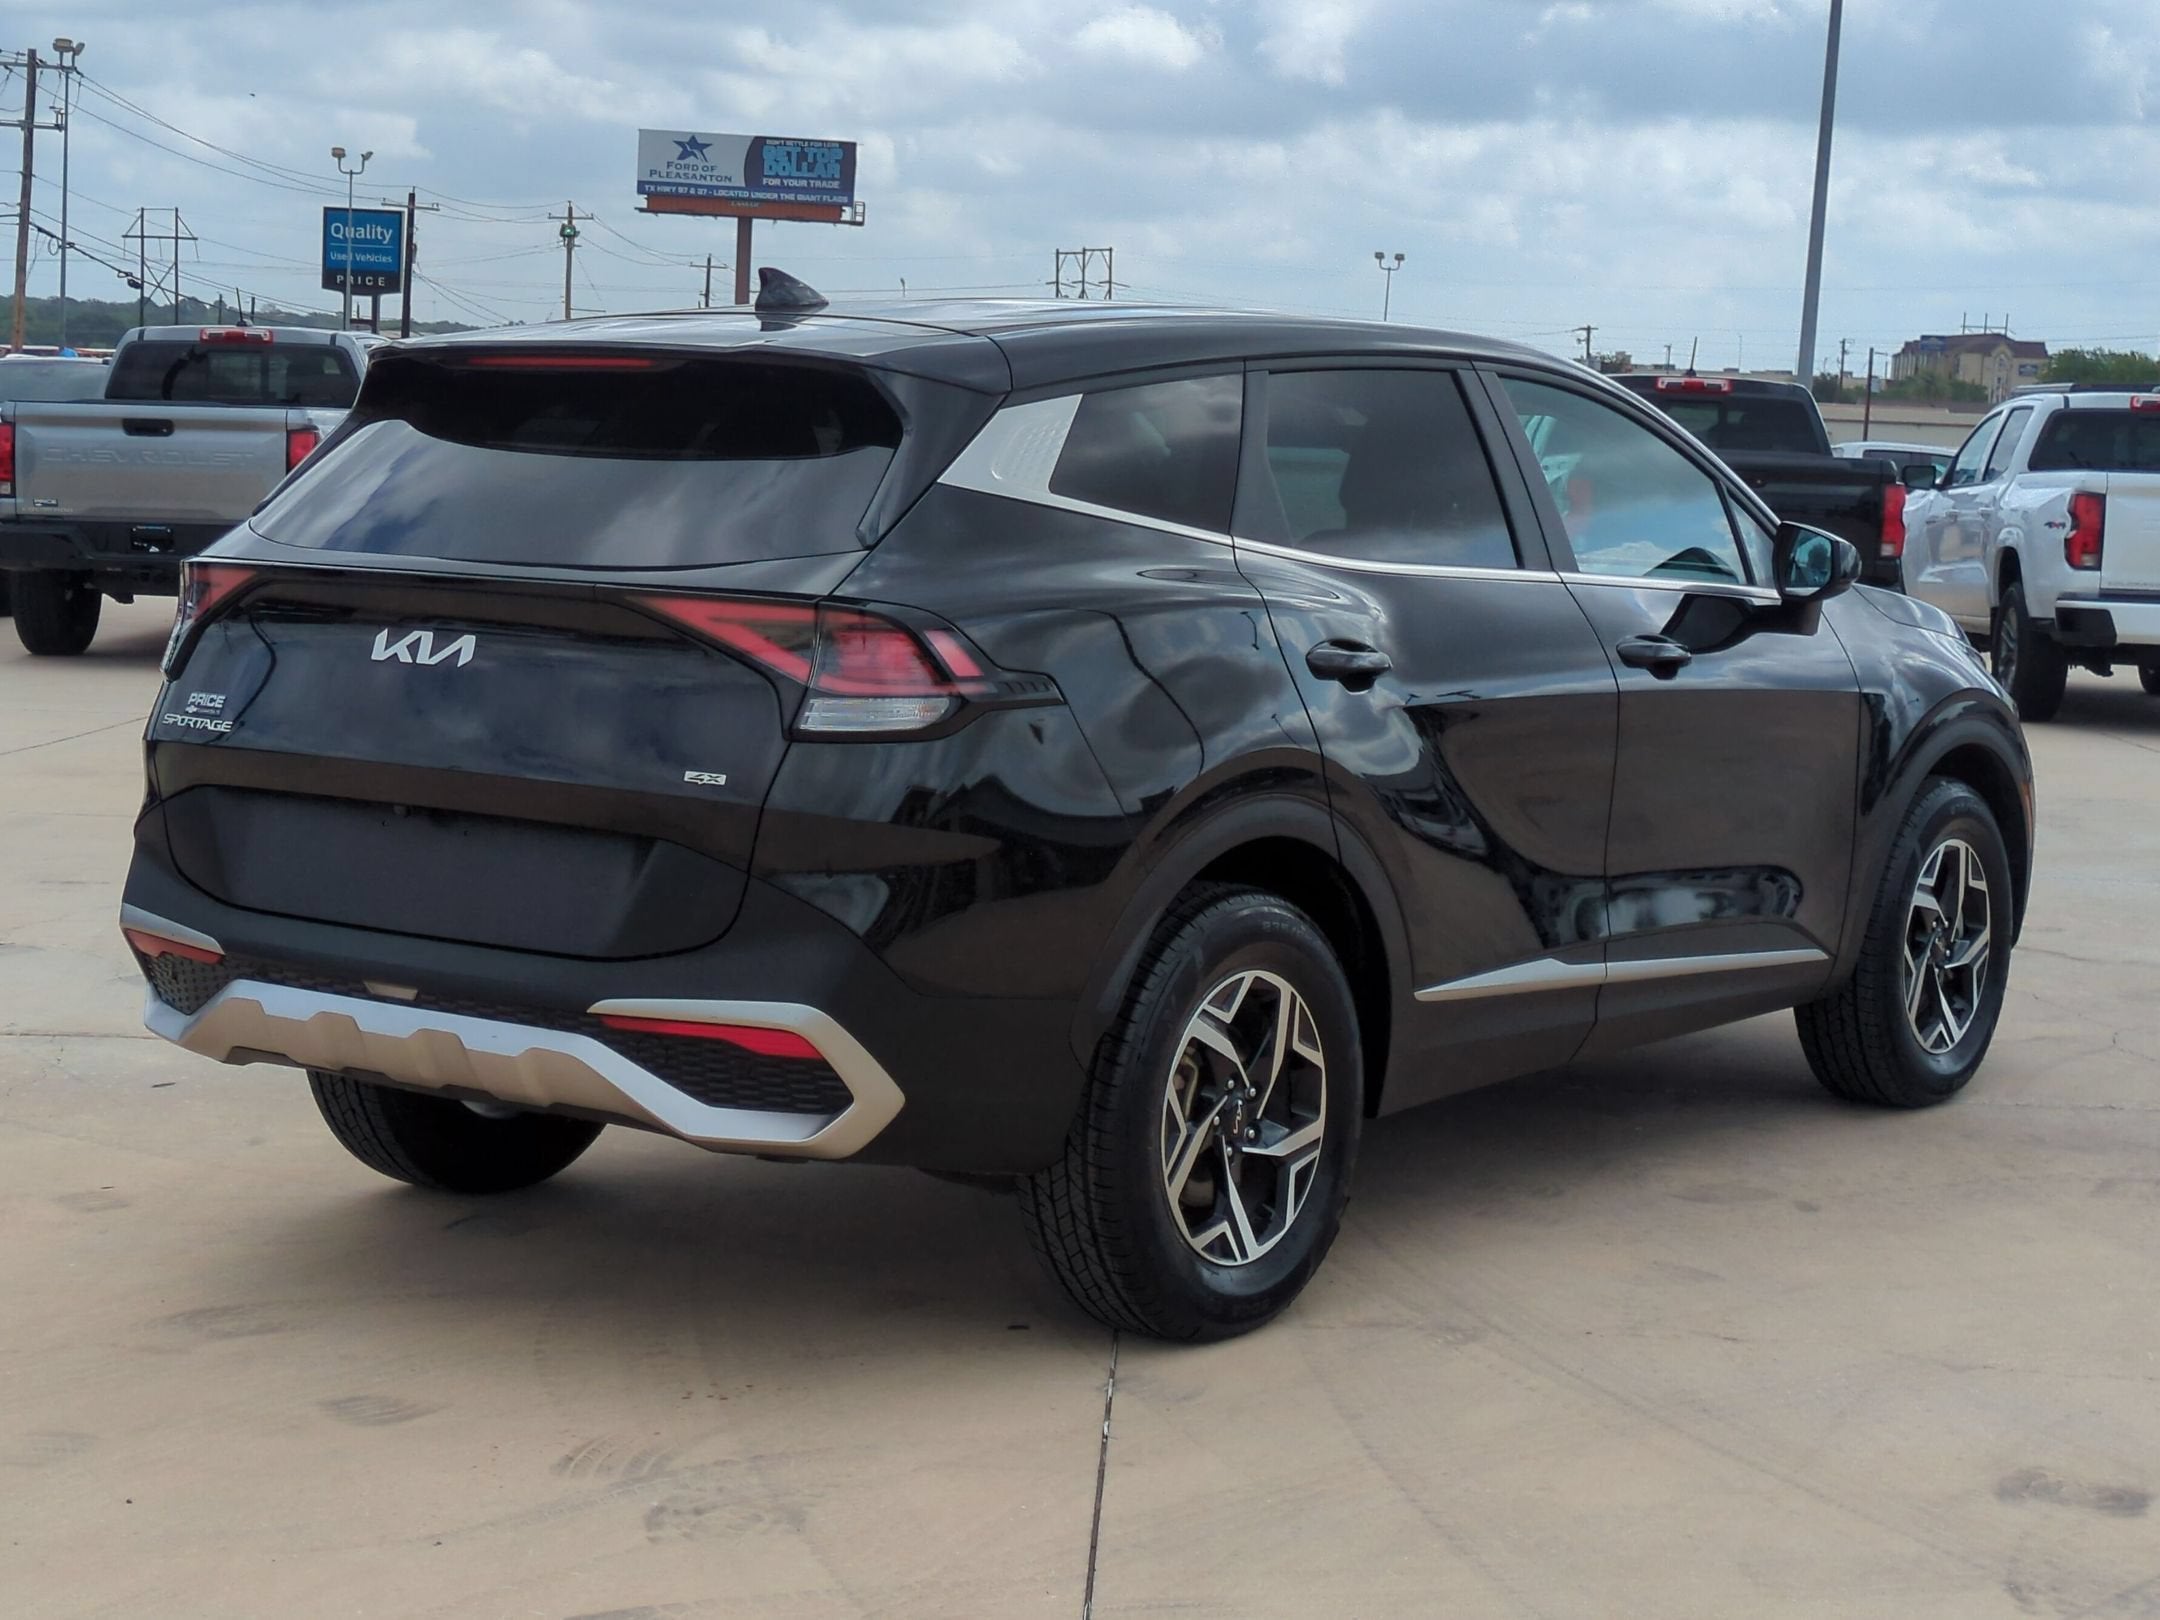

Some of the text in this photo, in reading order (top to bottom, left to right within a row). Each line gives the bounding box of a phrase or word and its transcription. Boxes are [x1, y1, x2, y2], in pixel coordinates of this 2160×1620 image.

[666, 161, 699, 172] FORD
[764, 158, 840, 178] DOLLAR
[649, 169, 732, 183] PLEASANTON
[762, 178, 840, 189] FOR YOUR TRADE
[330, 222, 393, 244] Quality
[355, 253, 392, 264] Vehicles
[370, 628, 476, 668] KIA
[188, 692, 226, 708] PRICE
[162, 713, 233, 732] SPORTAGE
